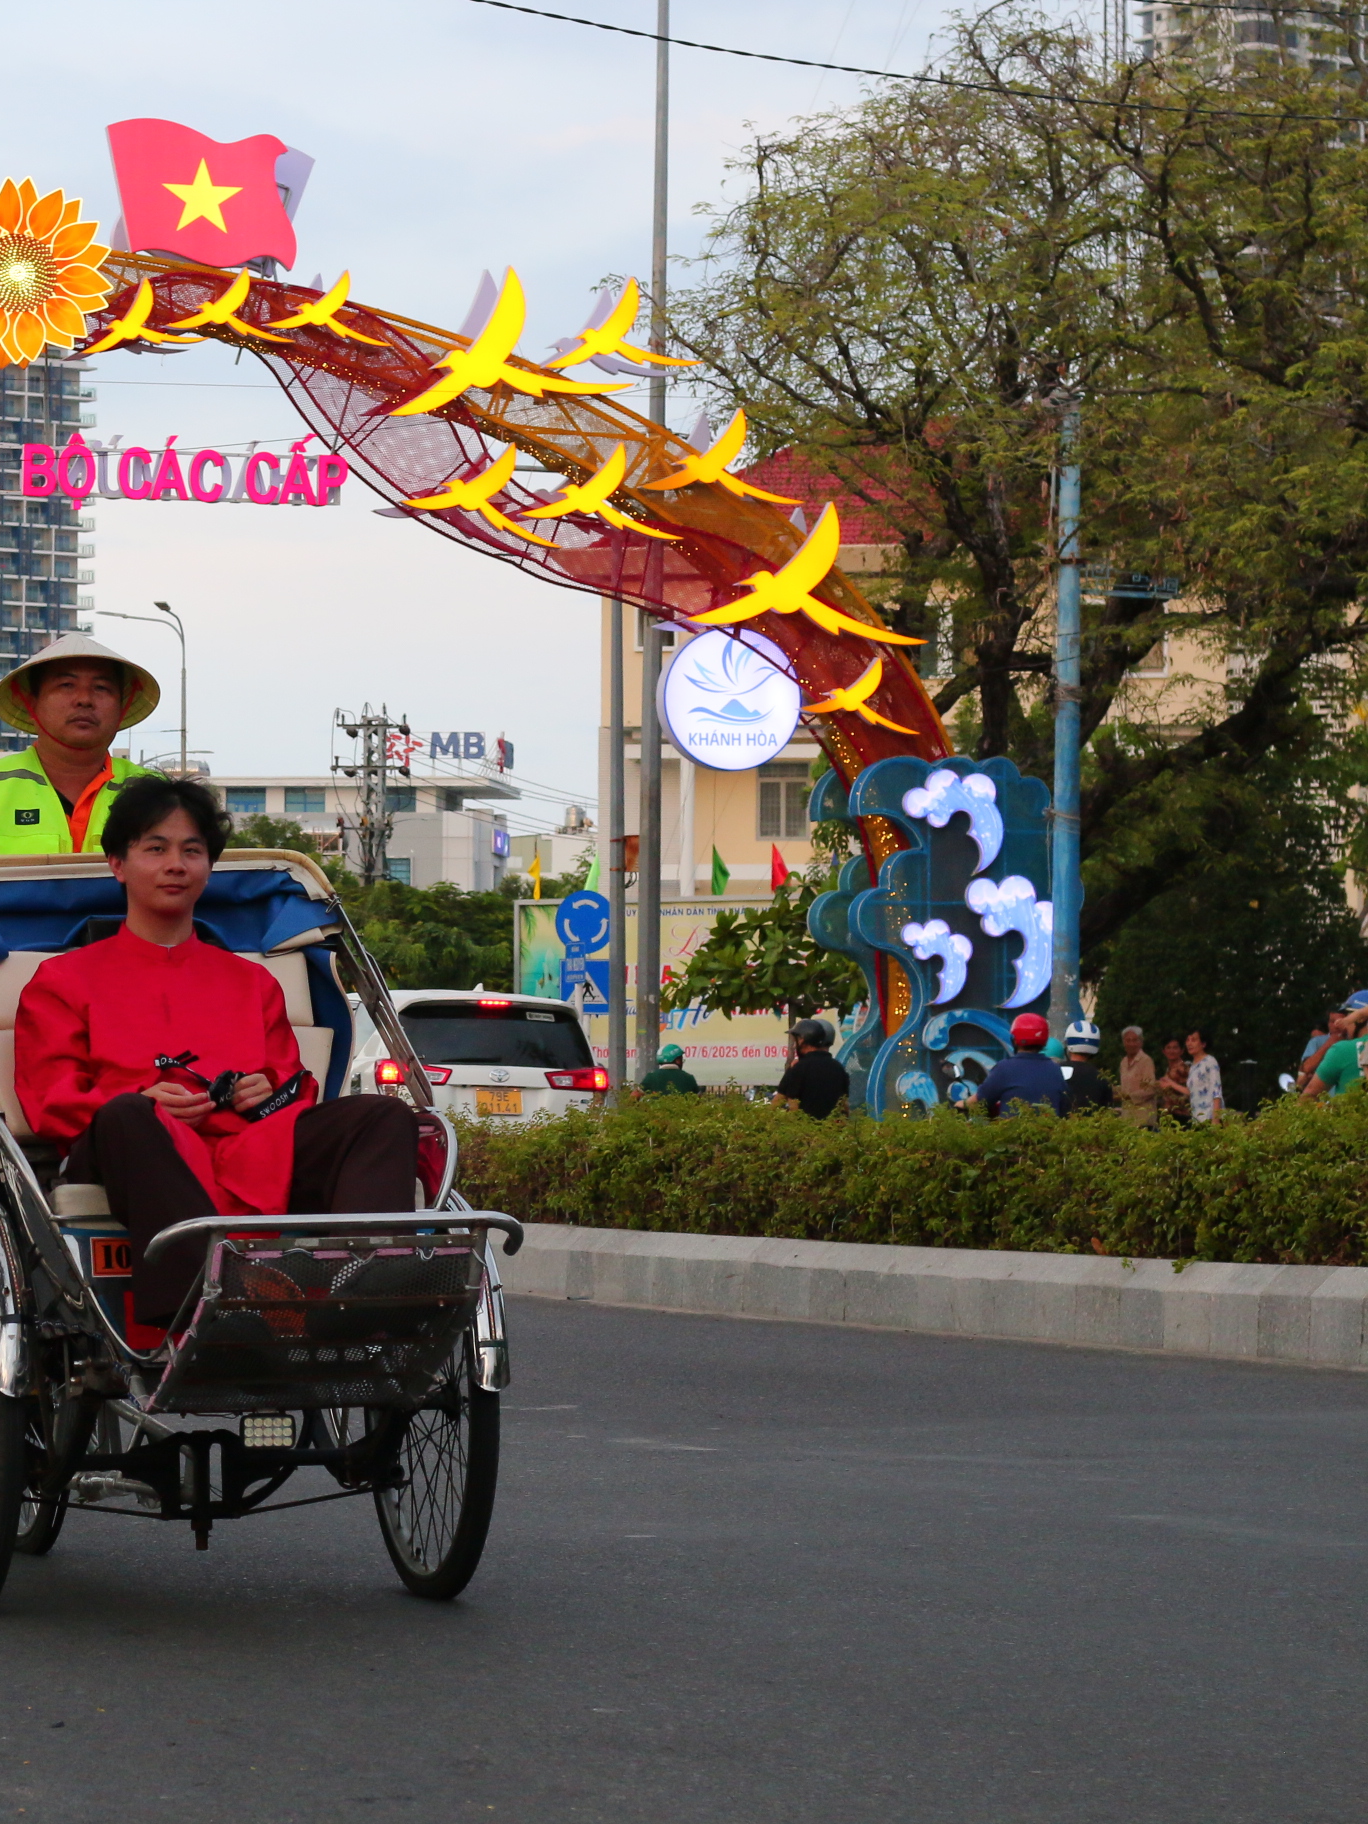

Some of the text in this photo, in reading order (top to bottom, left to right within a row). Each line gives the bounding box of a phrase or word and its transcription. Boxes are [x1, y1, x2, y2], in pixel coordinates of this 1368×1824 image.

[21, 432, 96, 511] BỘ
[117, 435, 225, 504] CÁC
[244, 433, 350, 507] CẤP
[429, 731, 486, 760] MB
[688, 729, 778, 747] KHÁNH HÒA
[259, 1091, 289, 1119] SWOOSH
[488, 1091, 510, 1102] 79E
